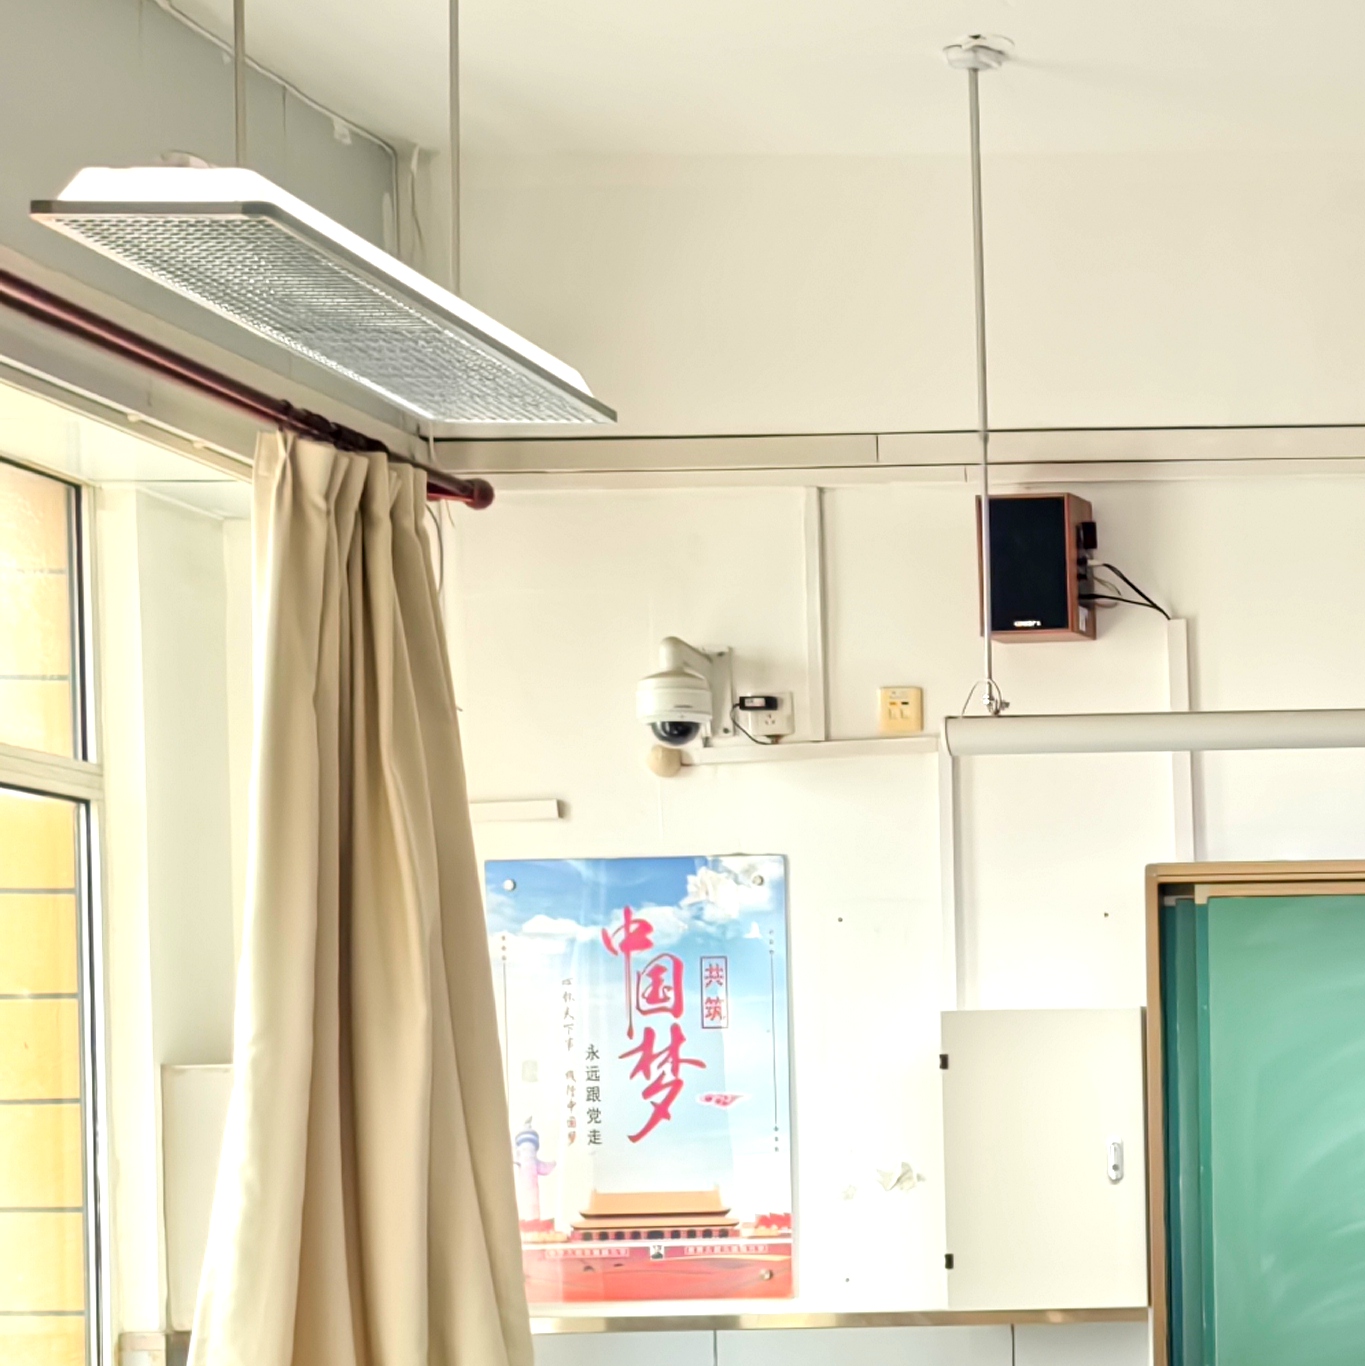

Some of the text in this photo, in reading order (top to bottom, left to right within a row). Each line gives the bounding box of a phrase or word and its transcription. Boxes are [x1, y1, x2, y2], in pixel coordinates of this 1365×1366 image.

[601, 906, 706, 1144] 中国梦
[704, 962, 726, 1022] 共筑
[585, 1043, 602, 1146] 永远跟党走
